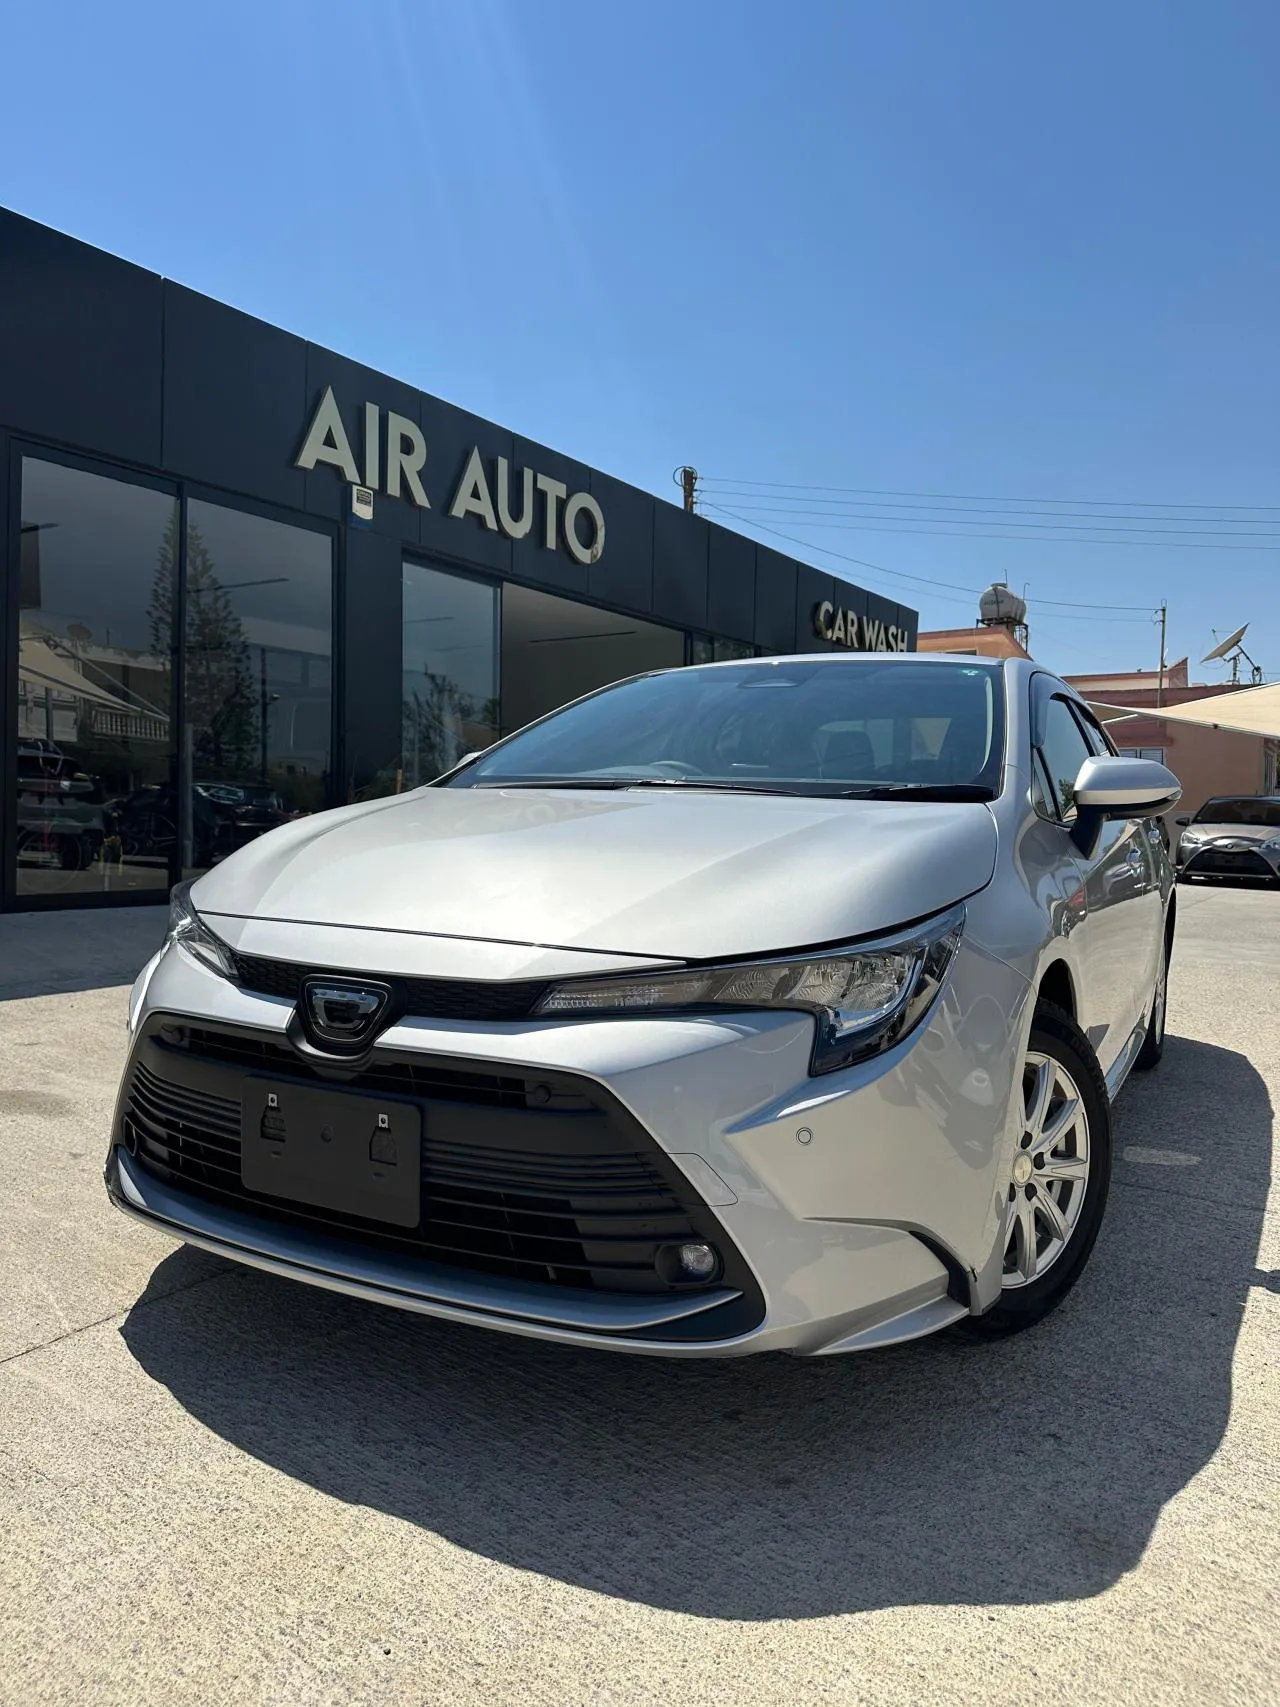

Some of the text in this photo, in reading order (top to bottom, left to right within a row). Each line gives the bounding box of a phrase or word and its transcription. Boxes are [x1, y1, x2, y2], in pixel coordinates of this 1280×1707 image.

[294, 385, 606, 564] AIR AUTO
[816, 600, 908, 652] CAR WASH
